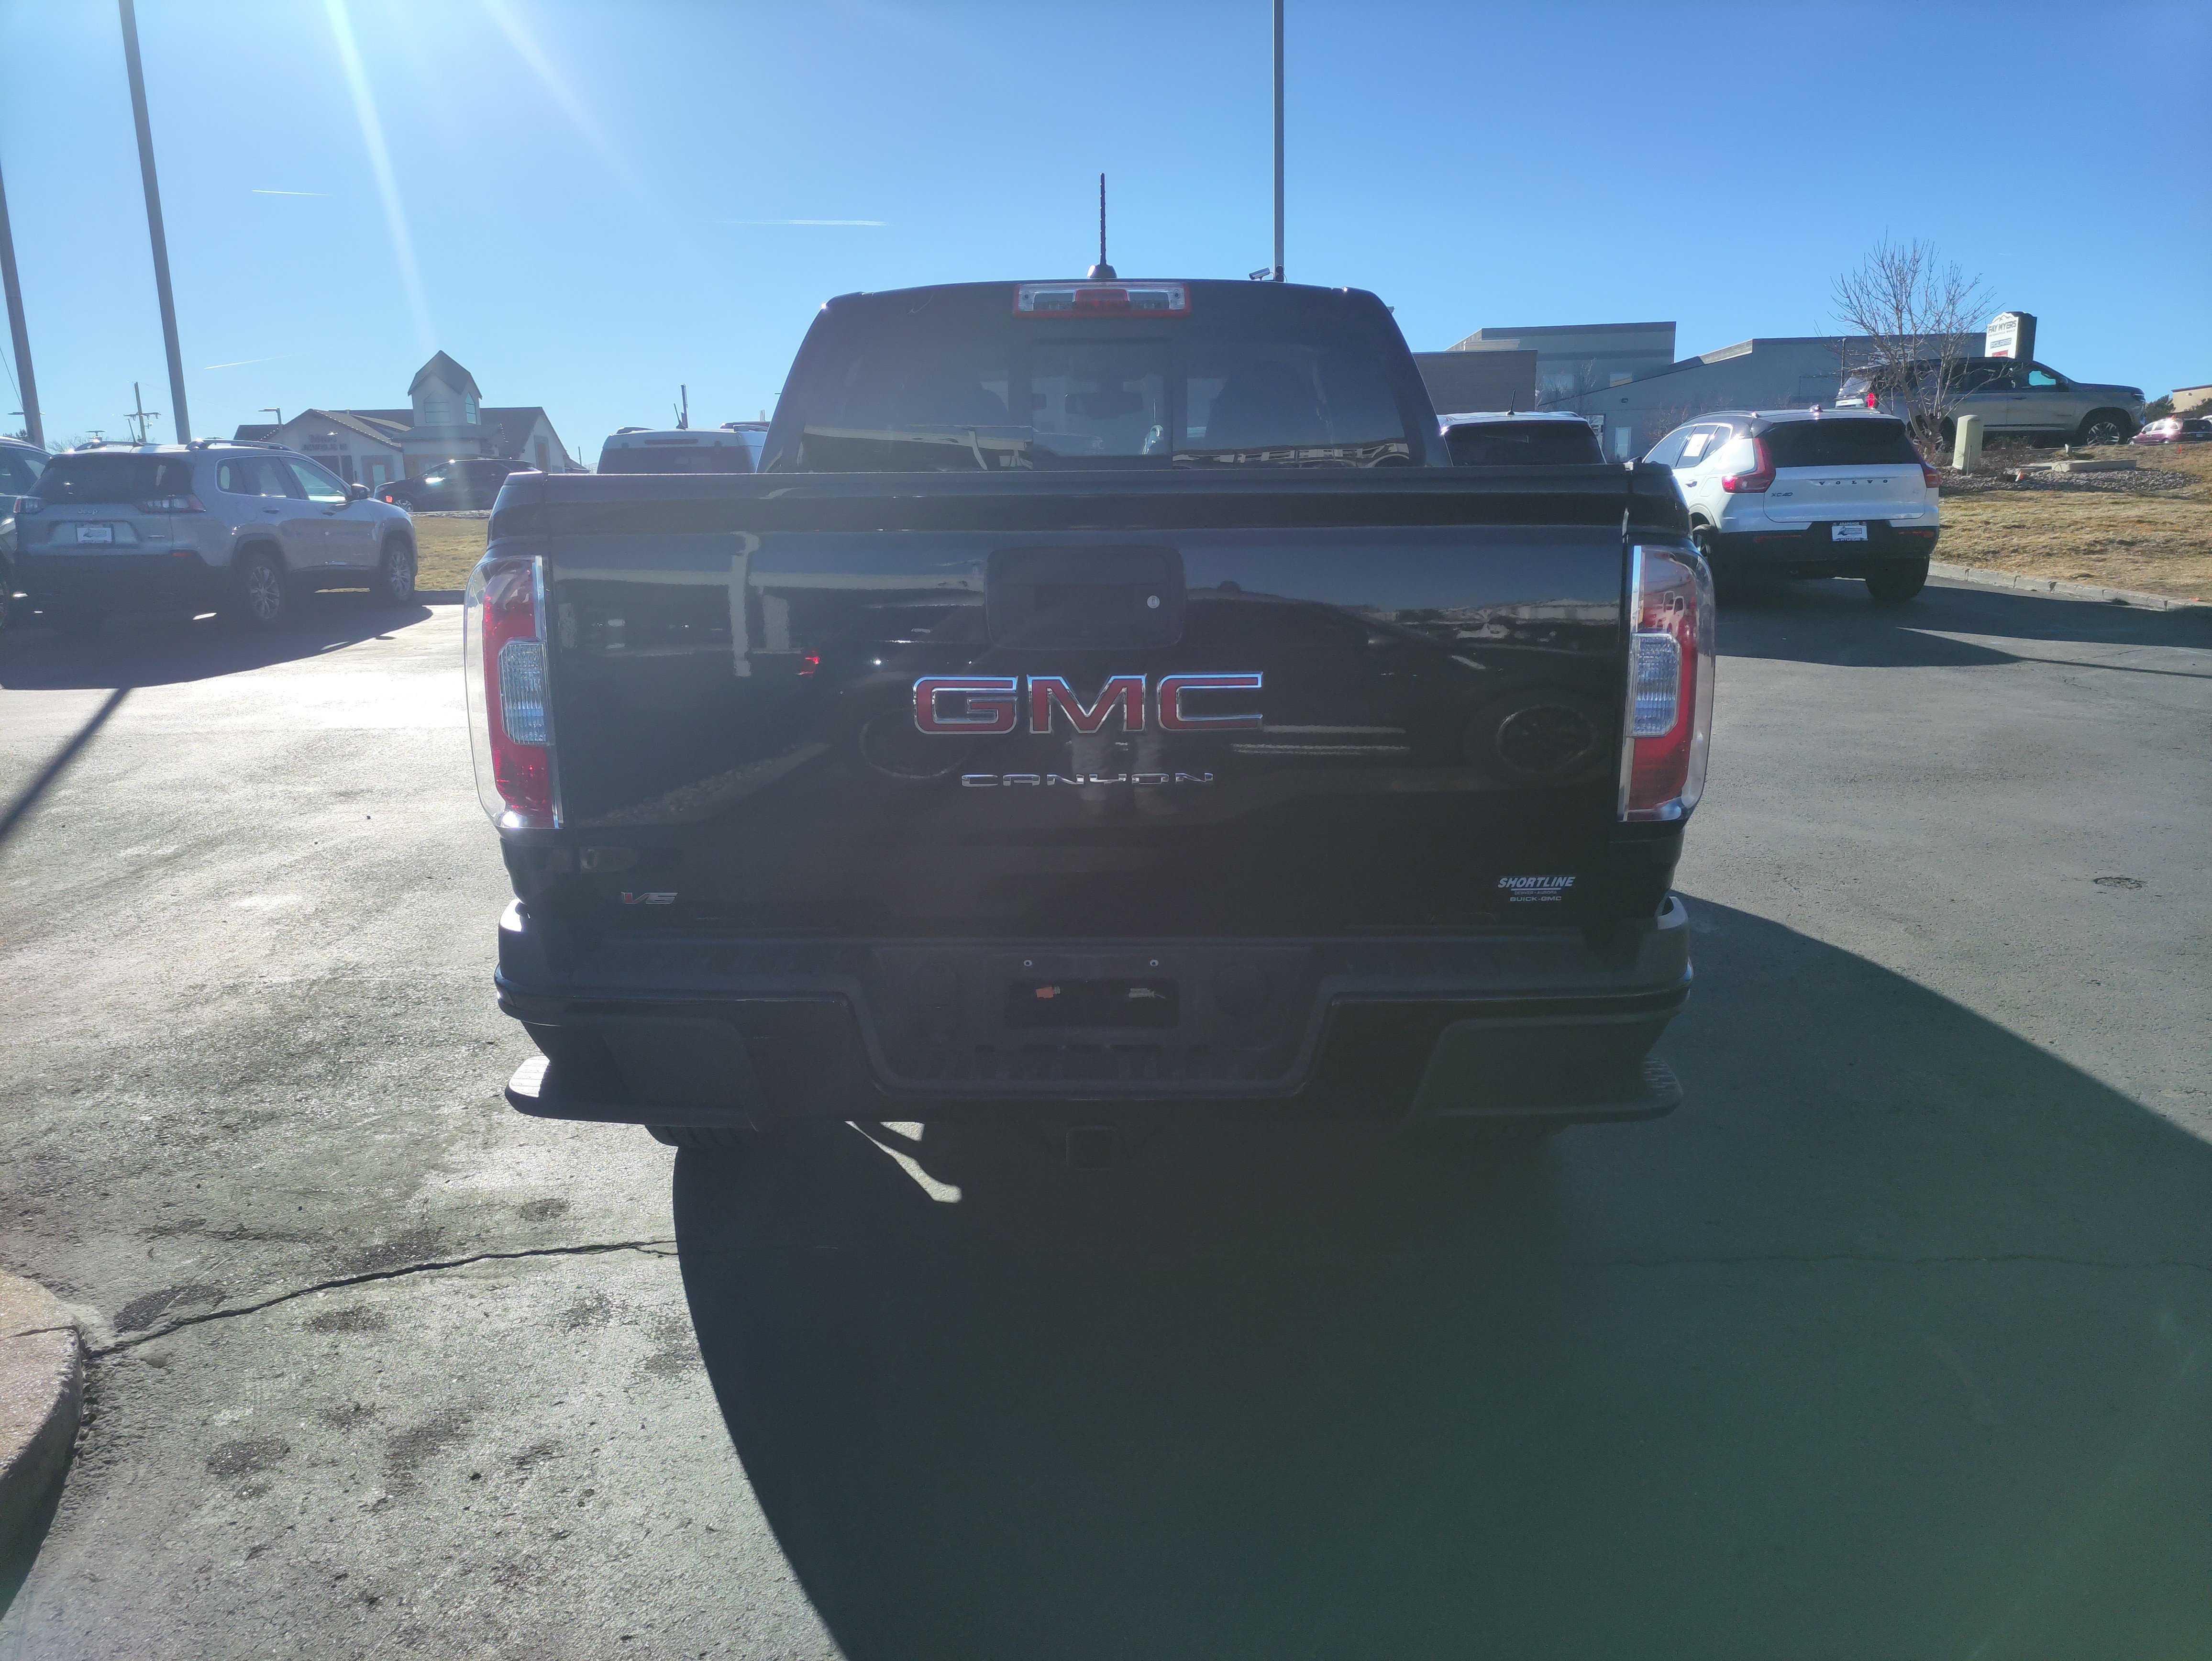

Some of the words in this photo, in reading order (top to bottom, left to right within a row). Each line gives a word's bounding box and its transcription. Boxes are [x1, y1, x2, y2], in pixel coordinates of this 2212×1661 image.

[1988, 324, 1998, 333] FAY
[1998, 320, 2017, 331] MYERS
[913, 672, 1263, 734] GMC
[961, 773, 1214, 787] CANYON
[1497, 876, 1576, 888] SHORTLINE
[621, 892, 678, 904] V6
